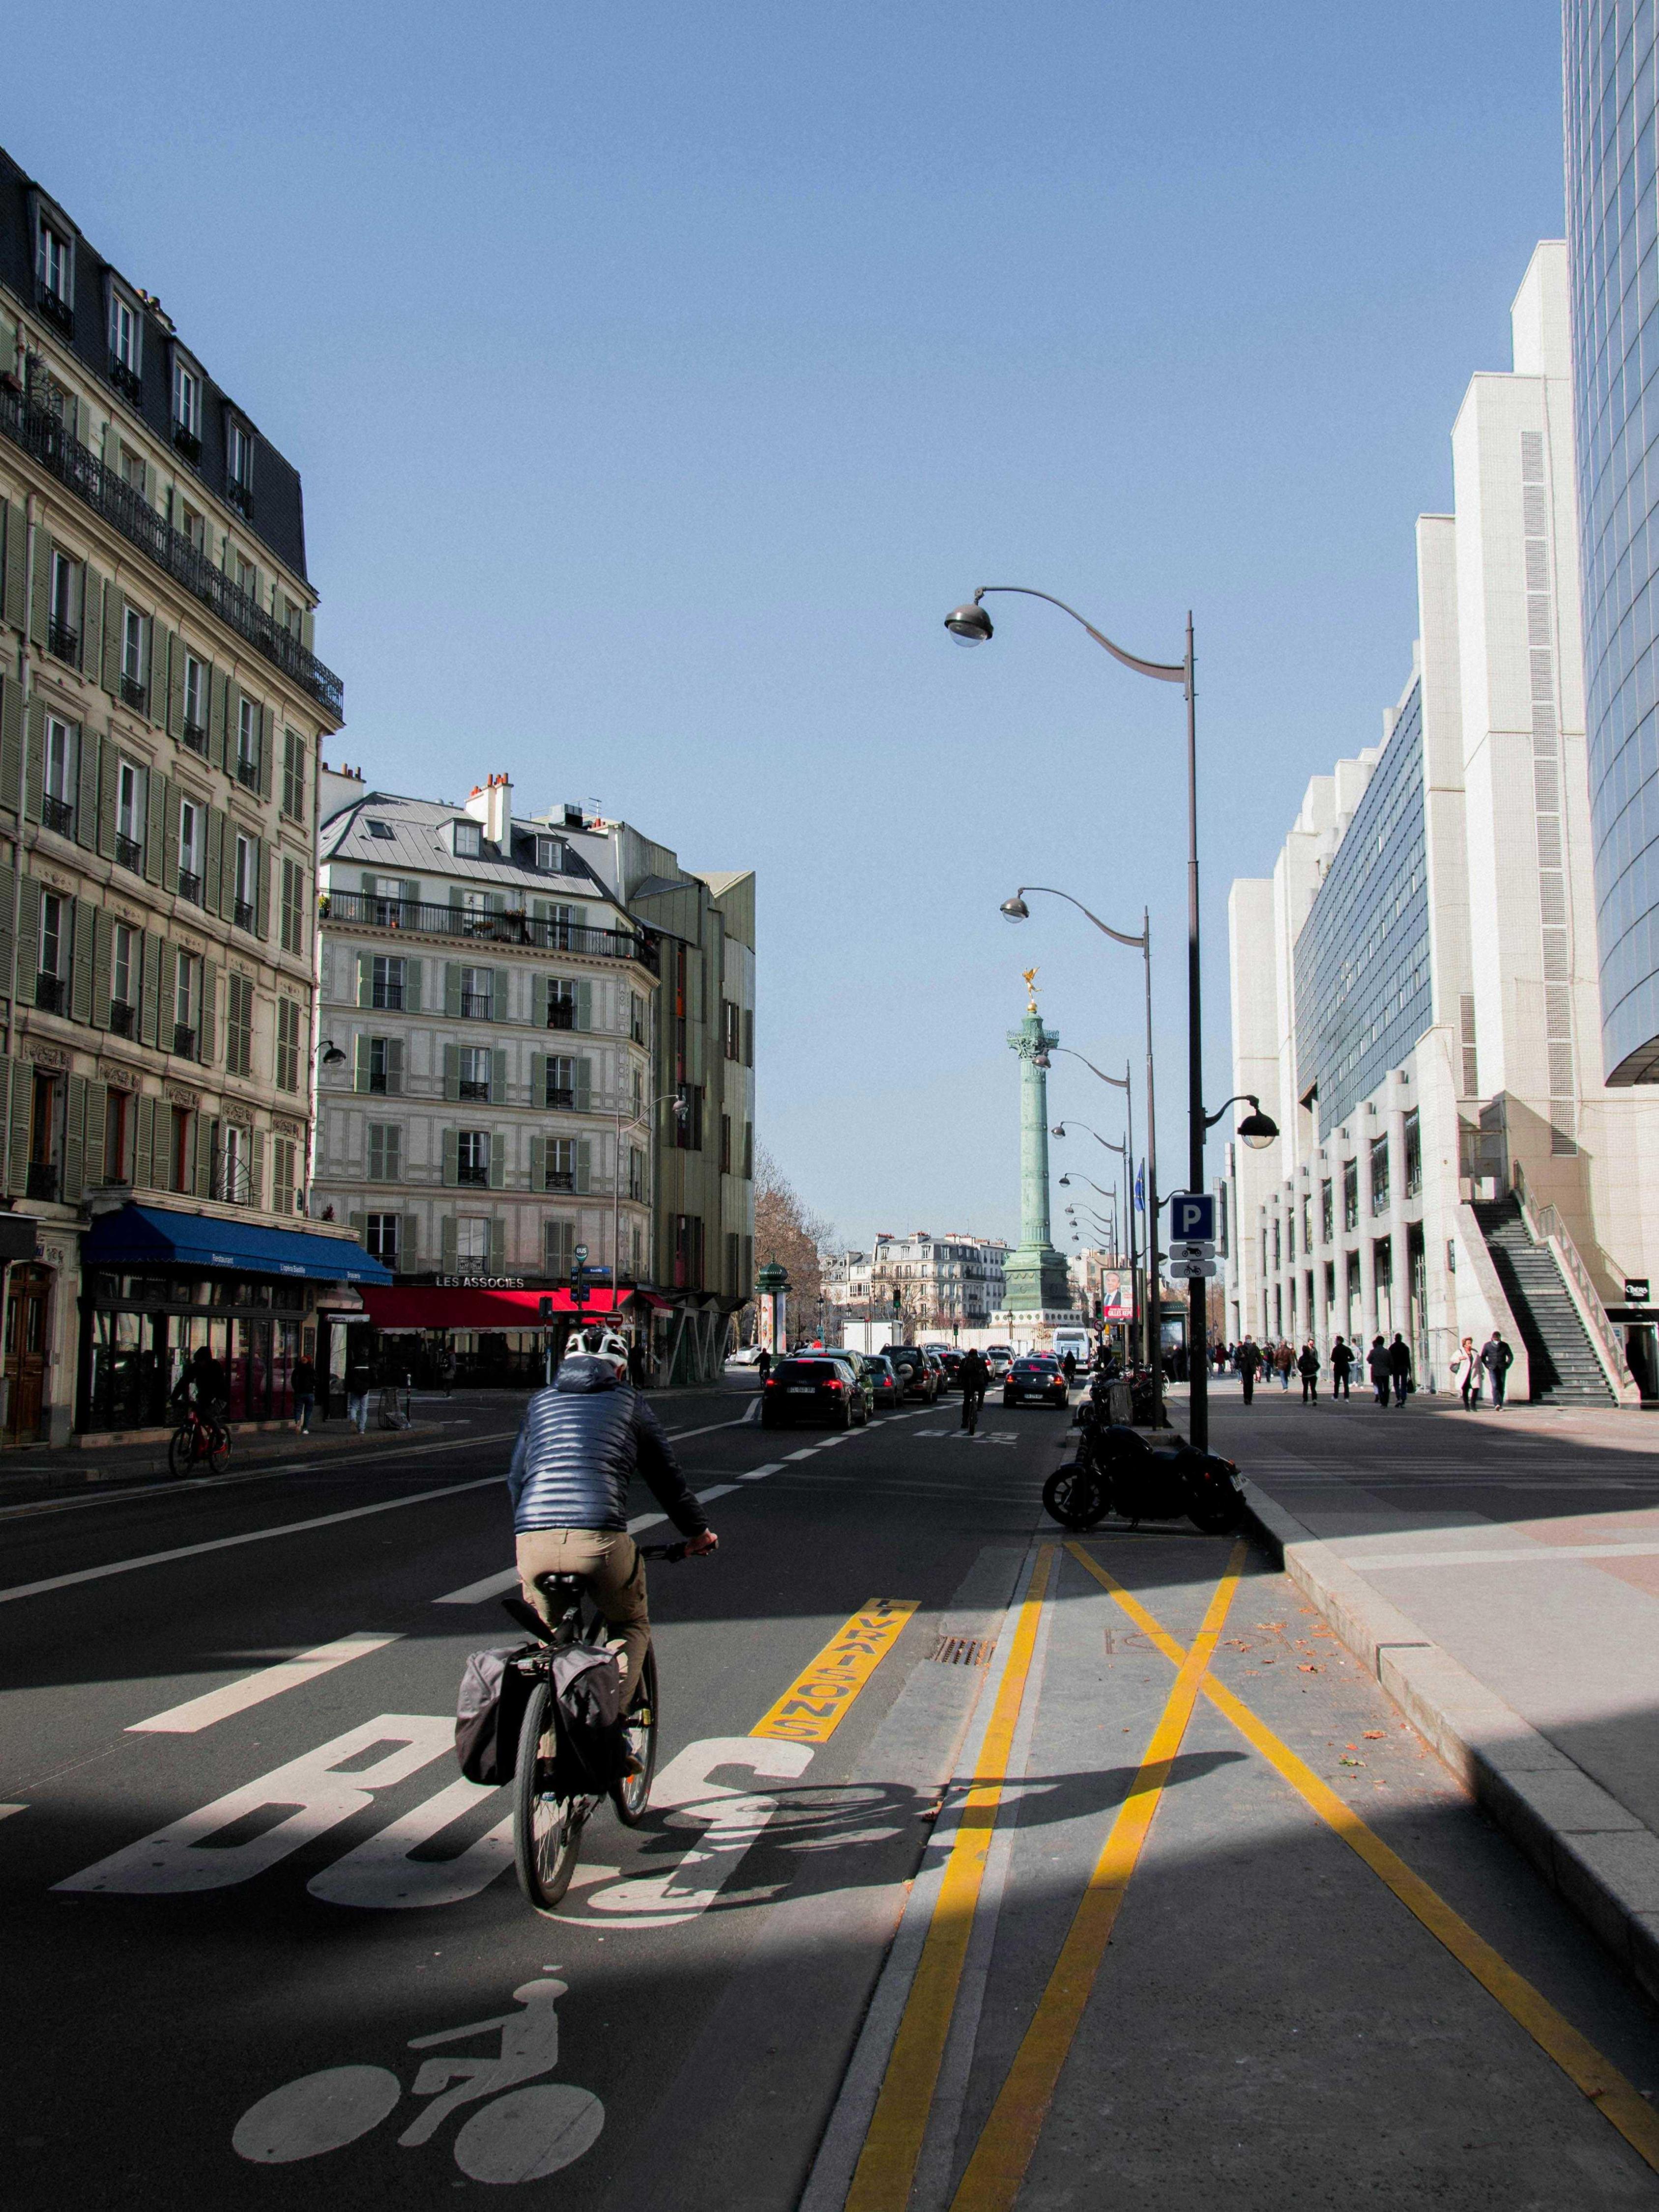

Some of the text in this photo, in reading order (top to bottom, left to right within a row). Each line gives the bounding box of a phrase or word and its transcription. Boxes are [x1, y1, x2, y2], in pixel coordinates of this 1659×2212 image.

[1183, 1204, 1201, 1232] P
[212, 1254, 233, 1264] Restaurant
[436, 1277, 524, 1288] LES ASSOCIES
[911, 1429, 1020, 1440] BUS
[764, 1599, 905, 1737] LIVRAISONS
[48, 1714, 816, 1928] BUS
